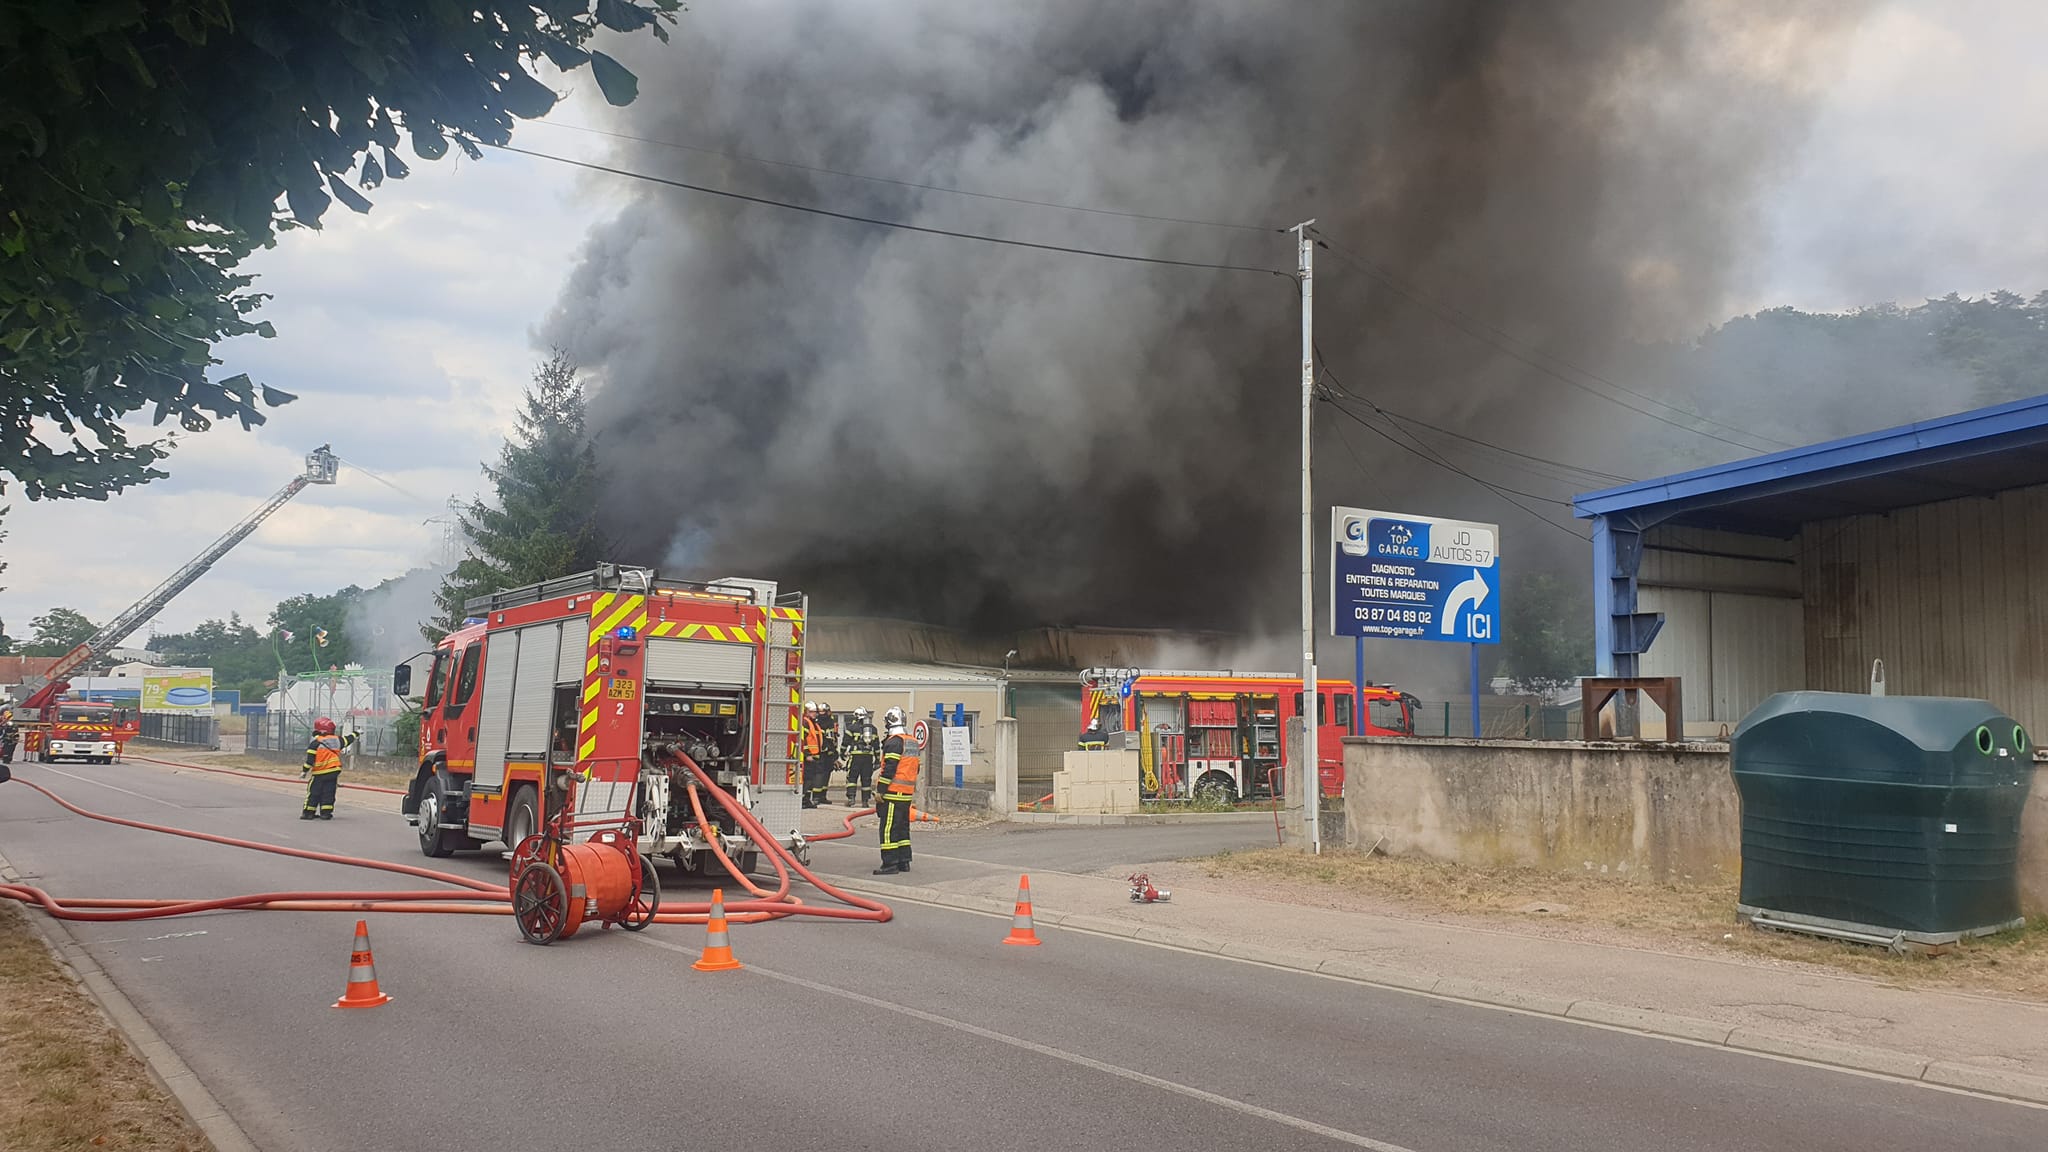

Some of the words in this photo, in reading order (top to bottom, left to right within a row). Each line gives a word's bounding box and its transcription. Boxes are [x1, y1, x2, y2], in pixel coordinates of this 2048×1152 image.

[1390, 534, 1409, 545] TOP
[1453, 531, 1471, 546] JD
[1378, 543, 1419, 557] GARAGE
[1433, 546, 1472, 562] AUTOS
[1475, 549, 1490, 563] 57
[1371, 563, 1415, 576] DIAGNOSTIC
[1346, 574, 1386, 586] ENTRETIEN
[1387, 578, 1393, 587] &
[1394, 578, 1440, 590] REPARATION
[1360, 587, 1389, 599] TOUTES
[1390, 590, 1426, 601] MARQUES
[1354, 607, 1369, 620] 03
[1371, 608, 1385, 620] 87
[1387, 609, 1400, 621] 04
[1403, 610, 1416, 622] 89
[1418, 611, 1431, 624] 02
[1362, 625, 1424, 636] www.top-garage.fr
[1467, 613, 1491, 639] ICI
[615, 679, 633, 689] 323
[624, 689, 635, 698] 57
[616, 702, 624, 715] 2
[916, 729, 925, 740] 20
